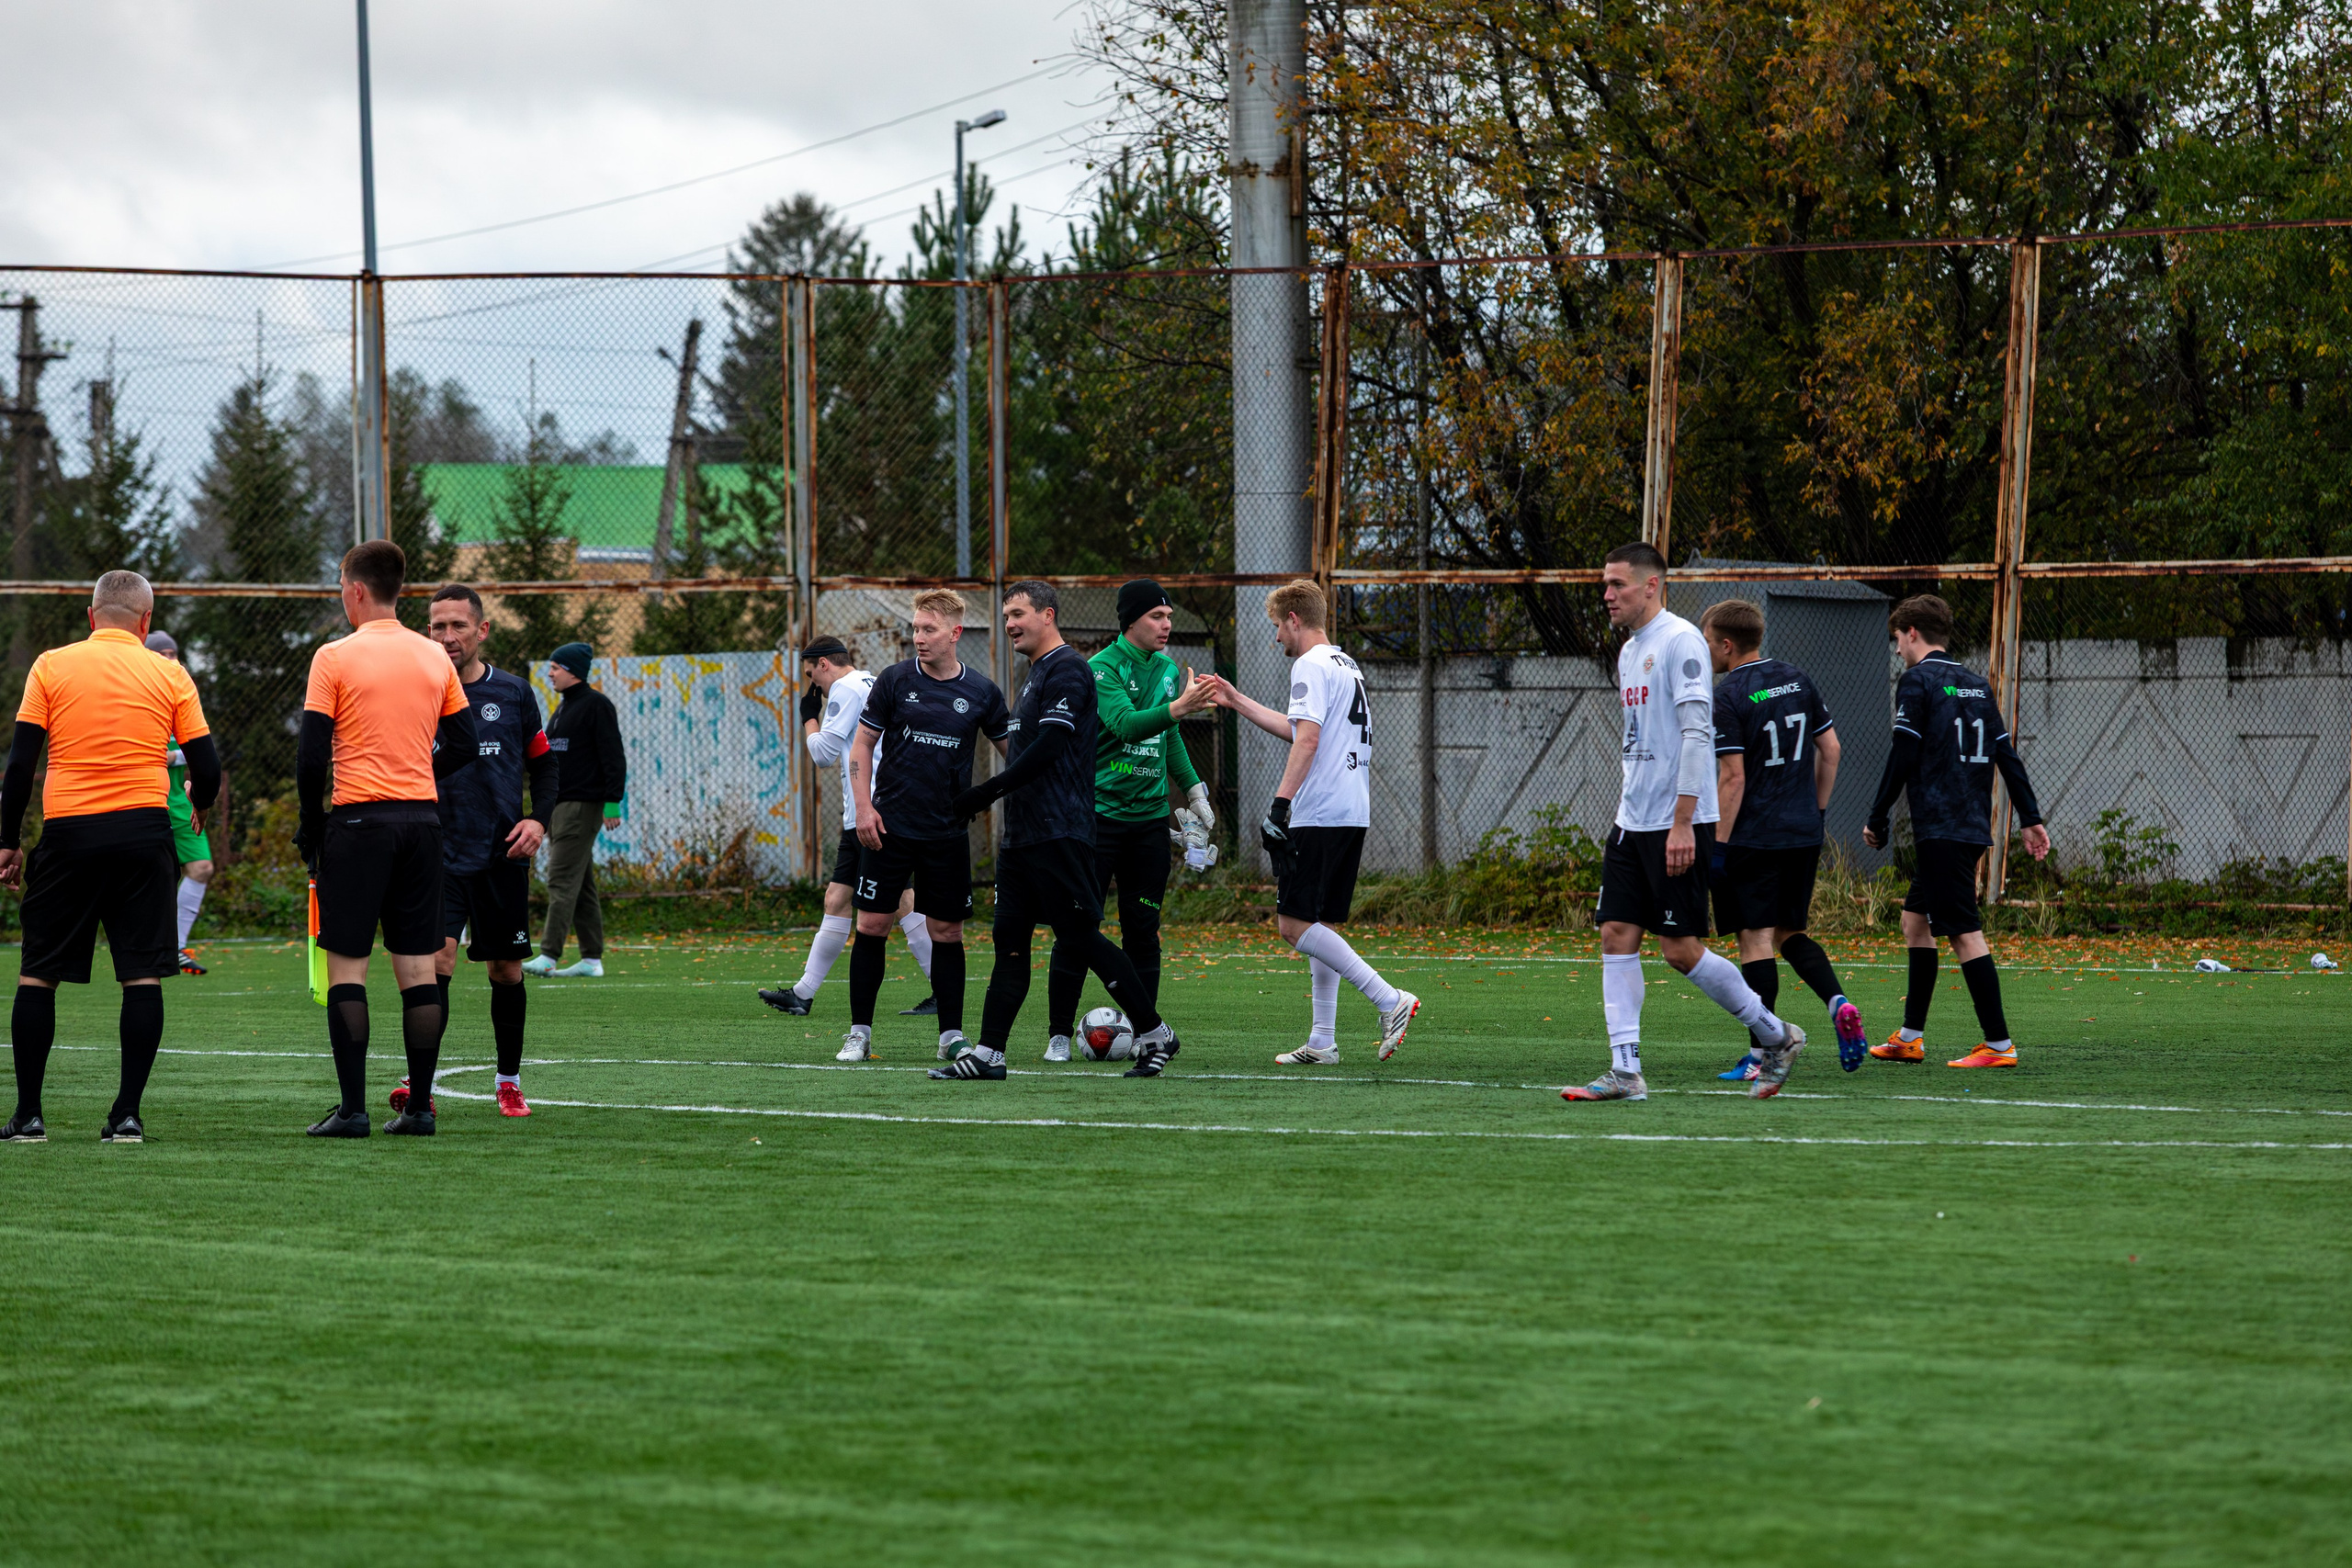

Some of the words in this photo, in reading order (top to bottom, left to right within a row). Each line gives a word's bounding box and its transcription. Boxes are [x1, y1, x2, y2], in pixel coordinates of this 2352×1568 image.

[1748, 682, 1801, 703] VINSERVICE
[1348, 677, 1372, 746] 4
[912, 735, 961, 749] TATNEFT
[1762, 712, 1807, 767] 17
[1954, 717, 1989, 763] 11
[856, 875, 878, 900] 13
